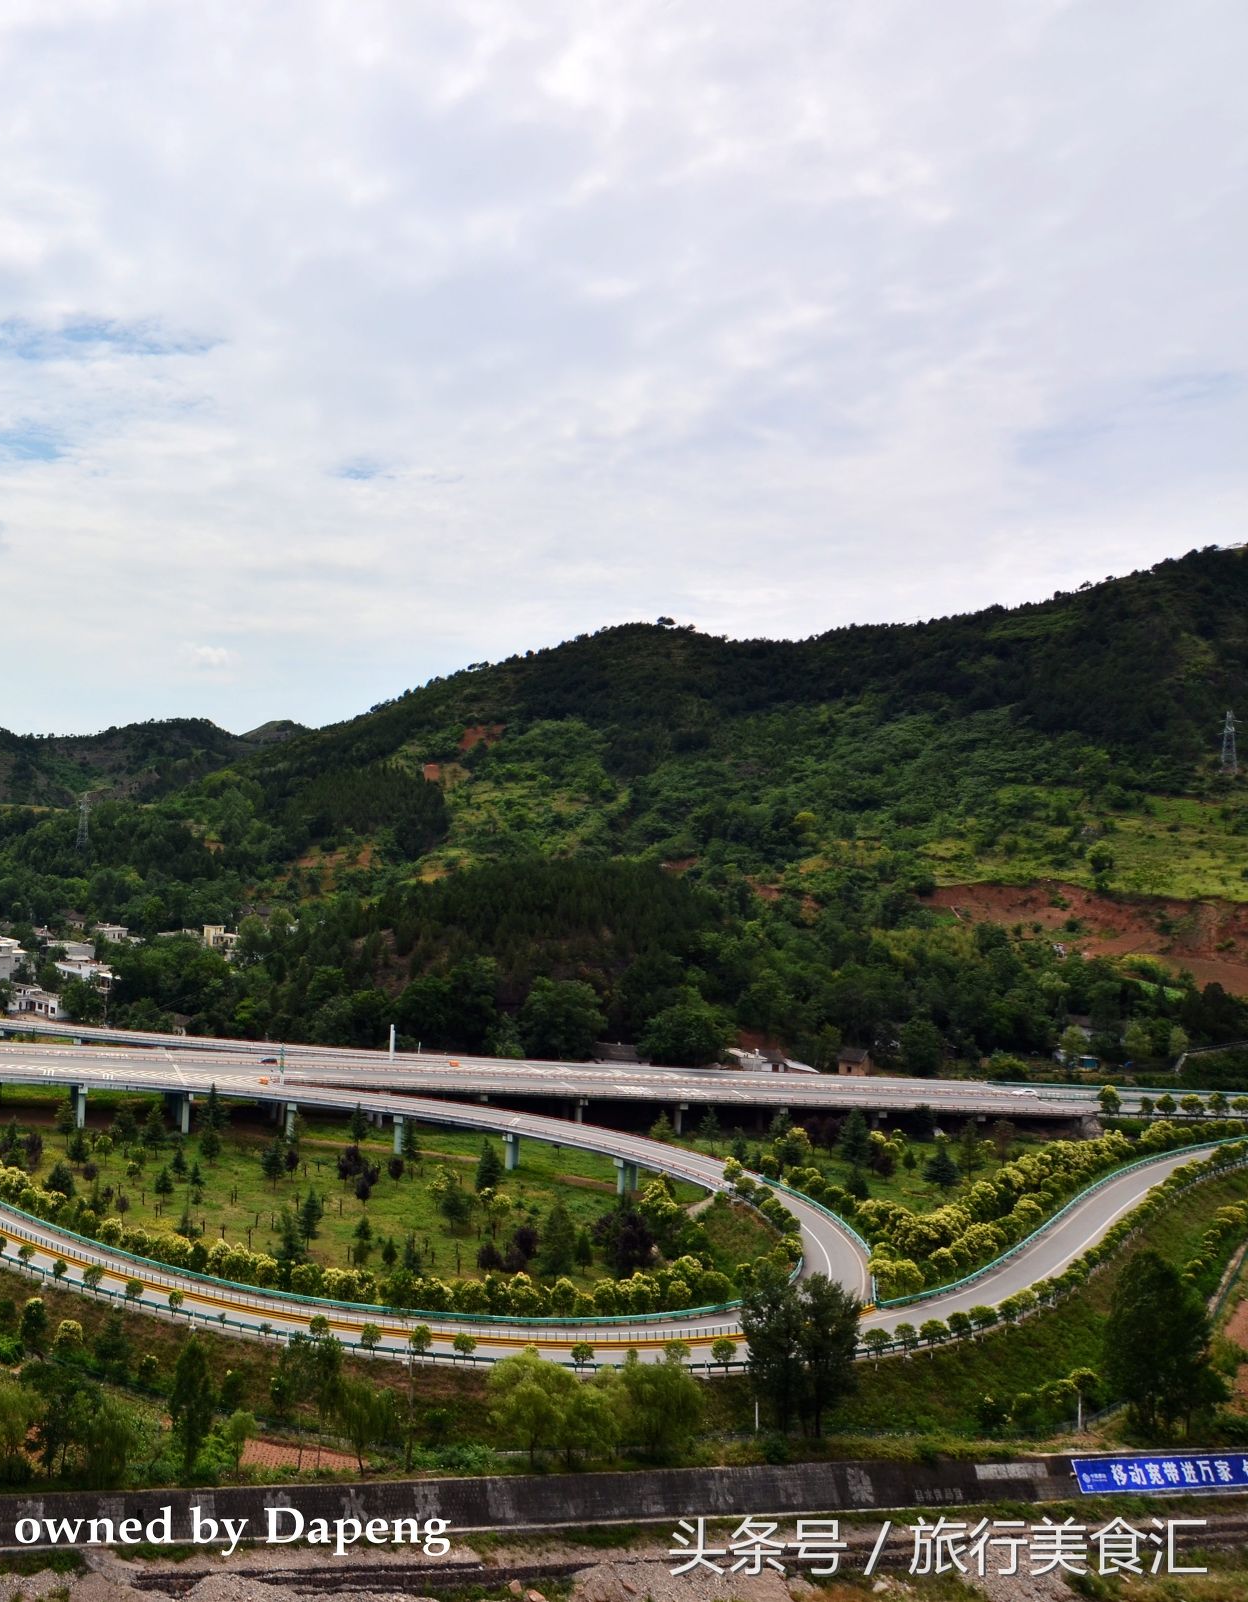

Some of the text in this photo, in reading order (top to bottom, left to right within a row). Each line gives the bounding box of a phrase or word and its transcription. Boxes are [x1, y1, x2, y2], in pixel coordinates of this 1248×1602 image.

[1110, 1458, 1234, 1486] 移动宽带进万家
